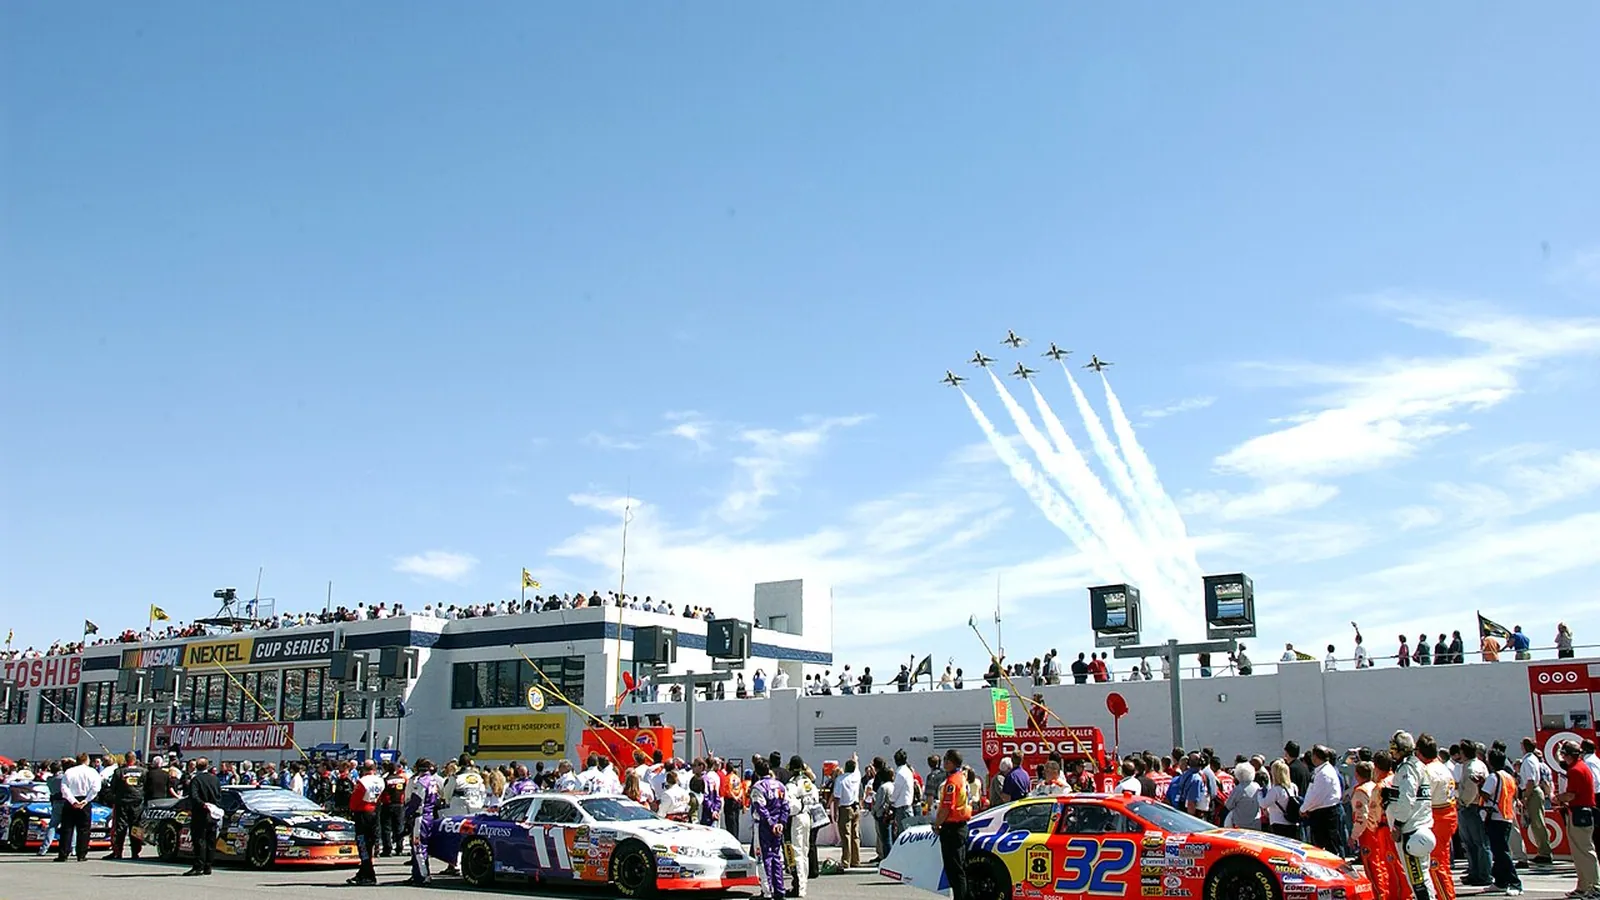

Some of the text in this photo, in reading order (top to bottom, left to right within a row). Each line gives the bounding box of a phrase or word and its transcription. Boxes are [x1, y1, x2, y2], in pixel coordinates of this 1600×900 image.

[189, 643, 245, 665] NEXTEL
[255, 637, 331, 658] CUP SERIES
[140, 647, 179, 668] NASCAR
[481, 724, 501, 732] POWER
[502, 723, 521, 731] MEETS
[1019, 730, 1040, 738] LOCAL
[1041, 729, 1065, 737] DODGE
[1002, 740, 1093, 755] DODGE
[438, 818, 476, 834] FedEx
[477, 824, 512, 838] Express
[527, 825, 571, 870] 11
[1029, 851, 1050, 859] SUPER
[1031, 858, 1047, 873] 8
[1053, 836, 1138, 897] 32
[1186, 867, 1204, 878] 3M
[1029, 872, 1050, 881] MOTEL
